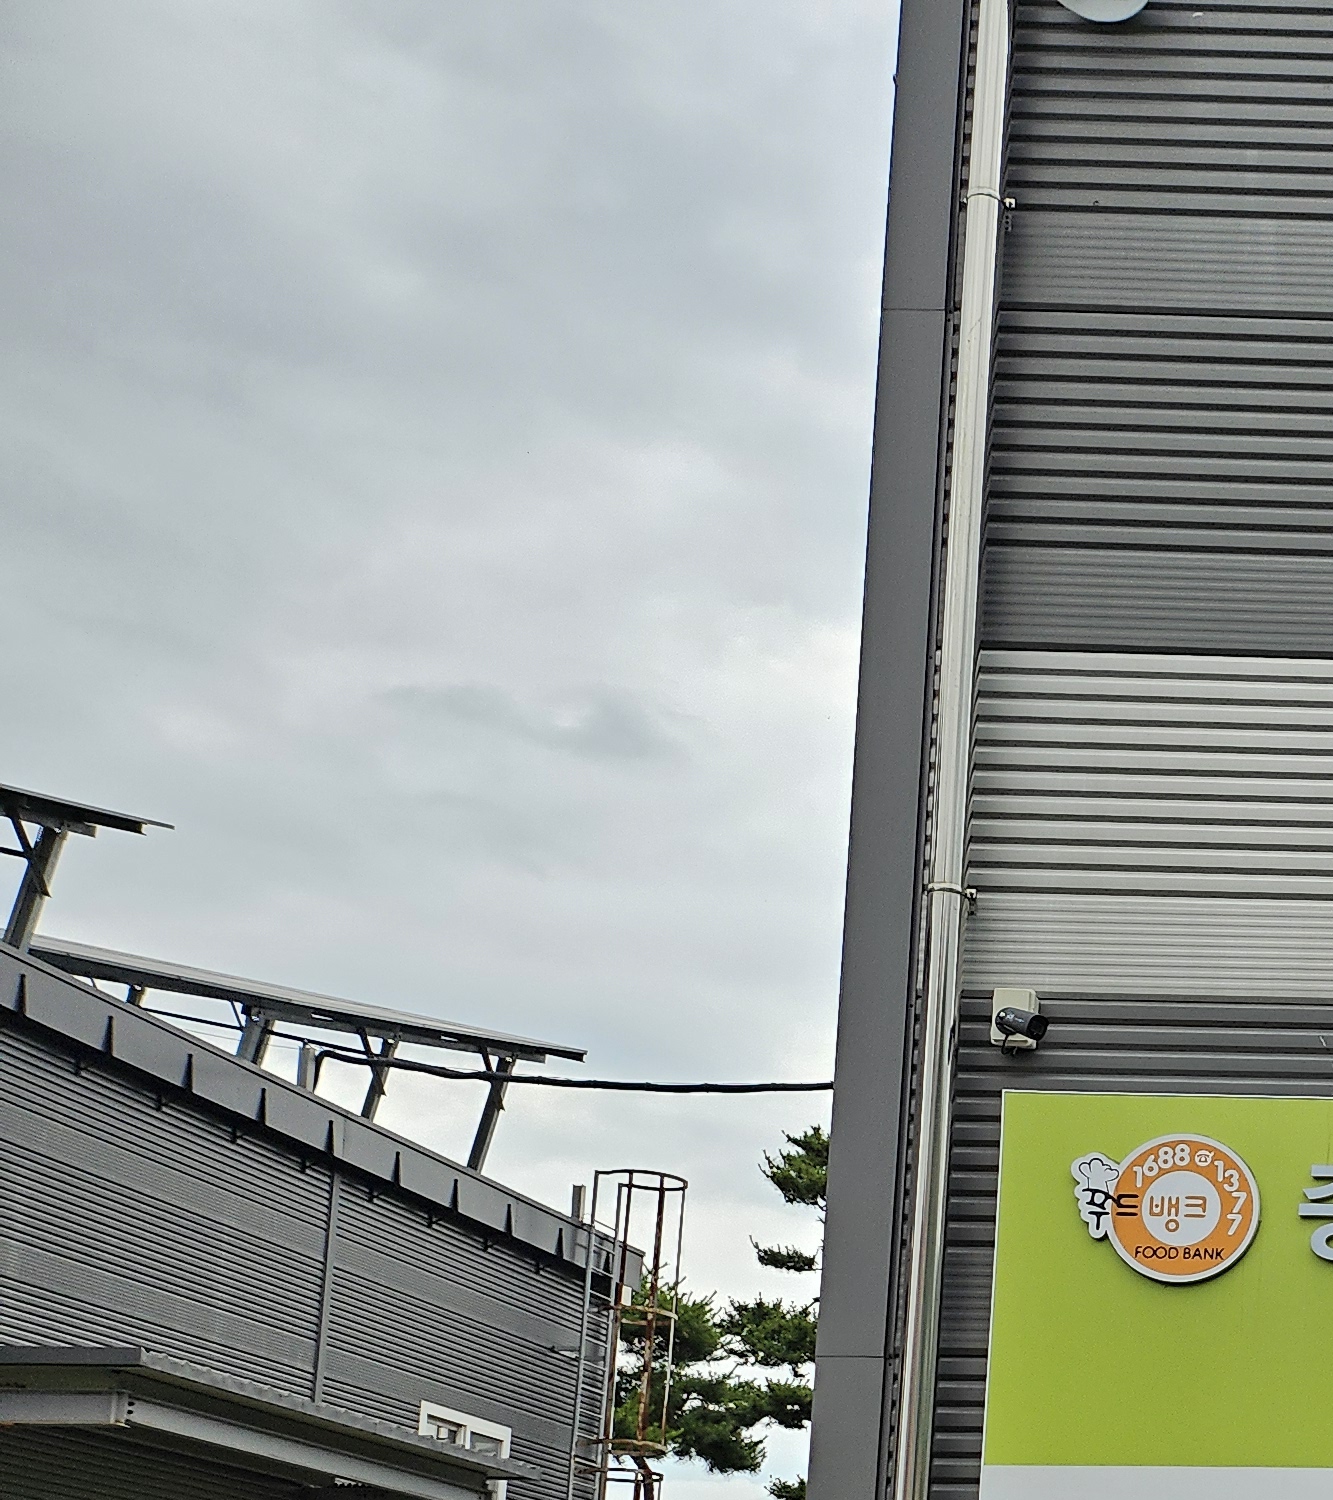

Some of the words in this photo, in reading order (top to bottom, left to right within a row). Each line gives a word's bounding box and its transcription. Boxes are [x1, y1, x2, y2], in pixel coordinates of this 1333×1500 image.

[1133, 1143, 1191, 1188] 1688
[1213, 1160, 1248, 1236] 1377
[1149, 1195, 1208, 1233] 뱅크
[1134, 1245, 1179, 1260] FOOD
[1183, 1246, 1226, 1261] BANK
